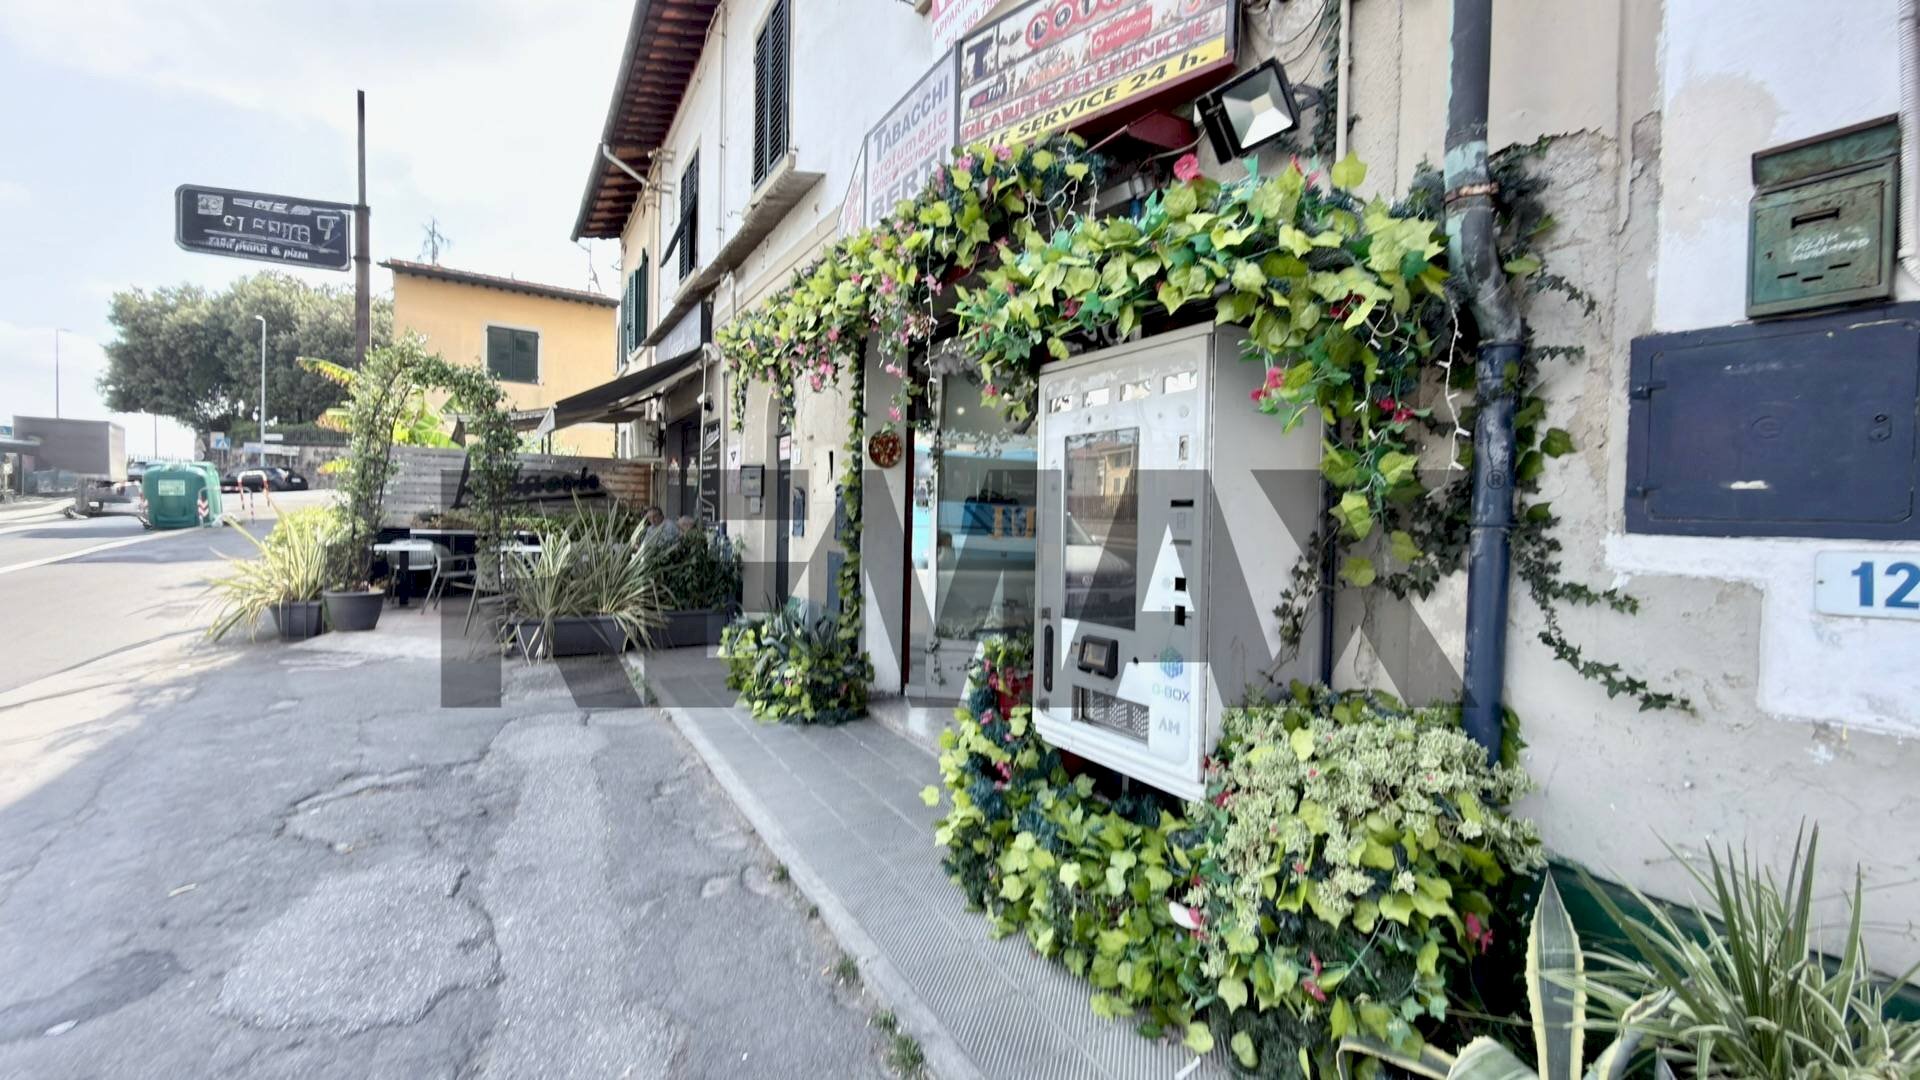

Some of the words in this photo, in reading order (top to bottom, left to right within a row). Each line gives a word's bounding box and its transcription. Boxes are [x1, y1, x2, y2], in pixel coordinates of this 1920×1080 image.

[1019, 85, 1118, 138] SERVICE
[1130, 64, 1167, 91] 24
[1851, 561, 1920, 608] 12
